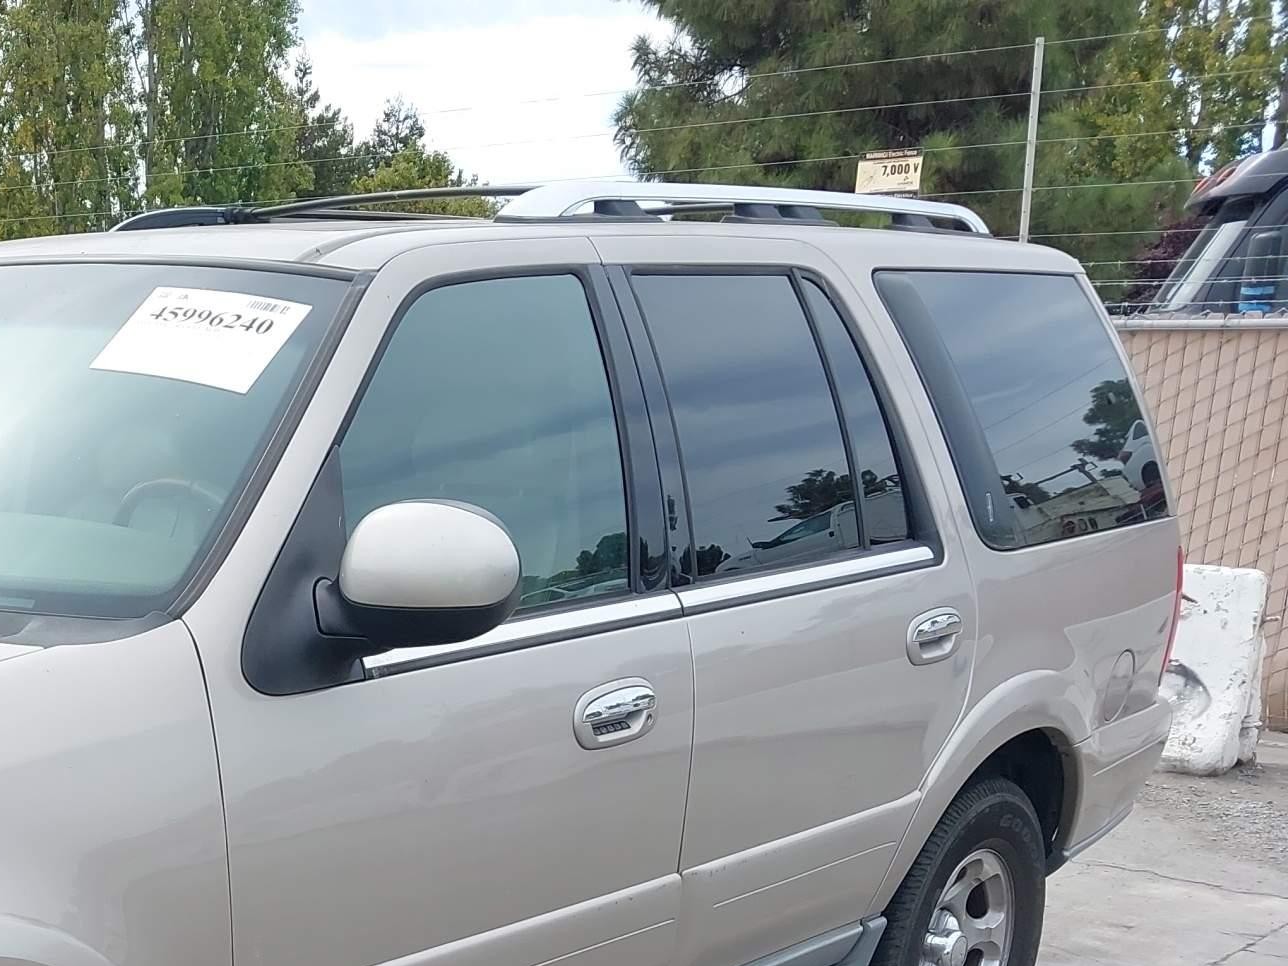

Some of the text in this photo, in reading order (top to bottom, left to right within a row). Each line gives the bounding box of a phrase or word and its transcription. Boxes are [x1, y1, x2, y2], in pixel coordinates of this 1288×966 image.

[882, 162, 920, 177] 7,000 V
[149, 305, 274, 335] 45996240
